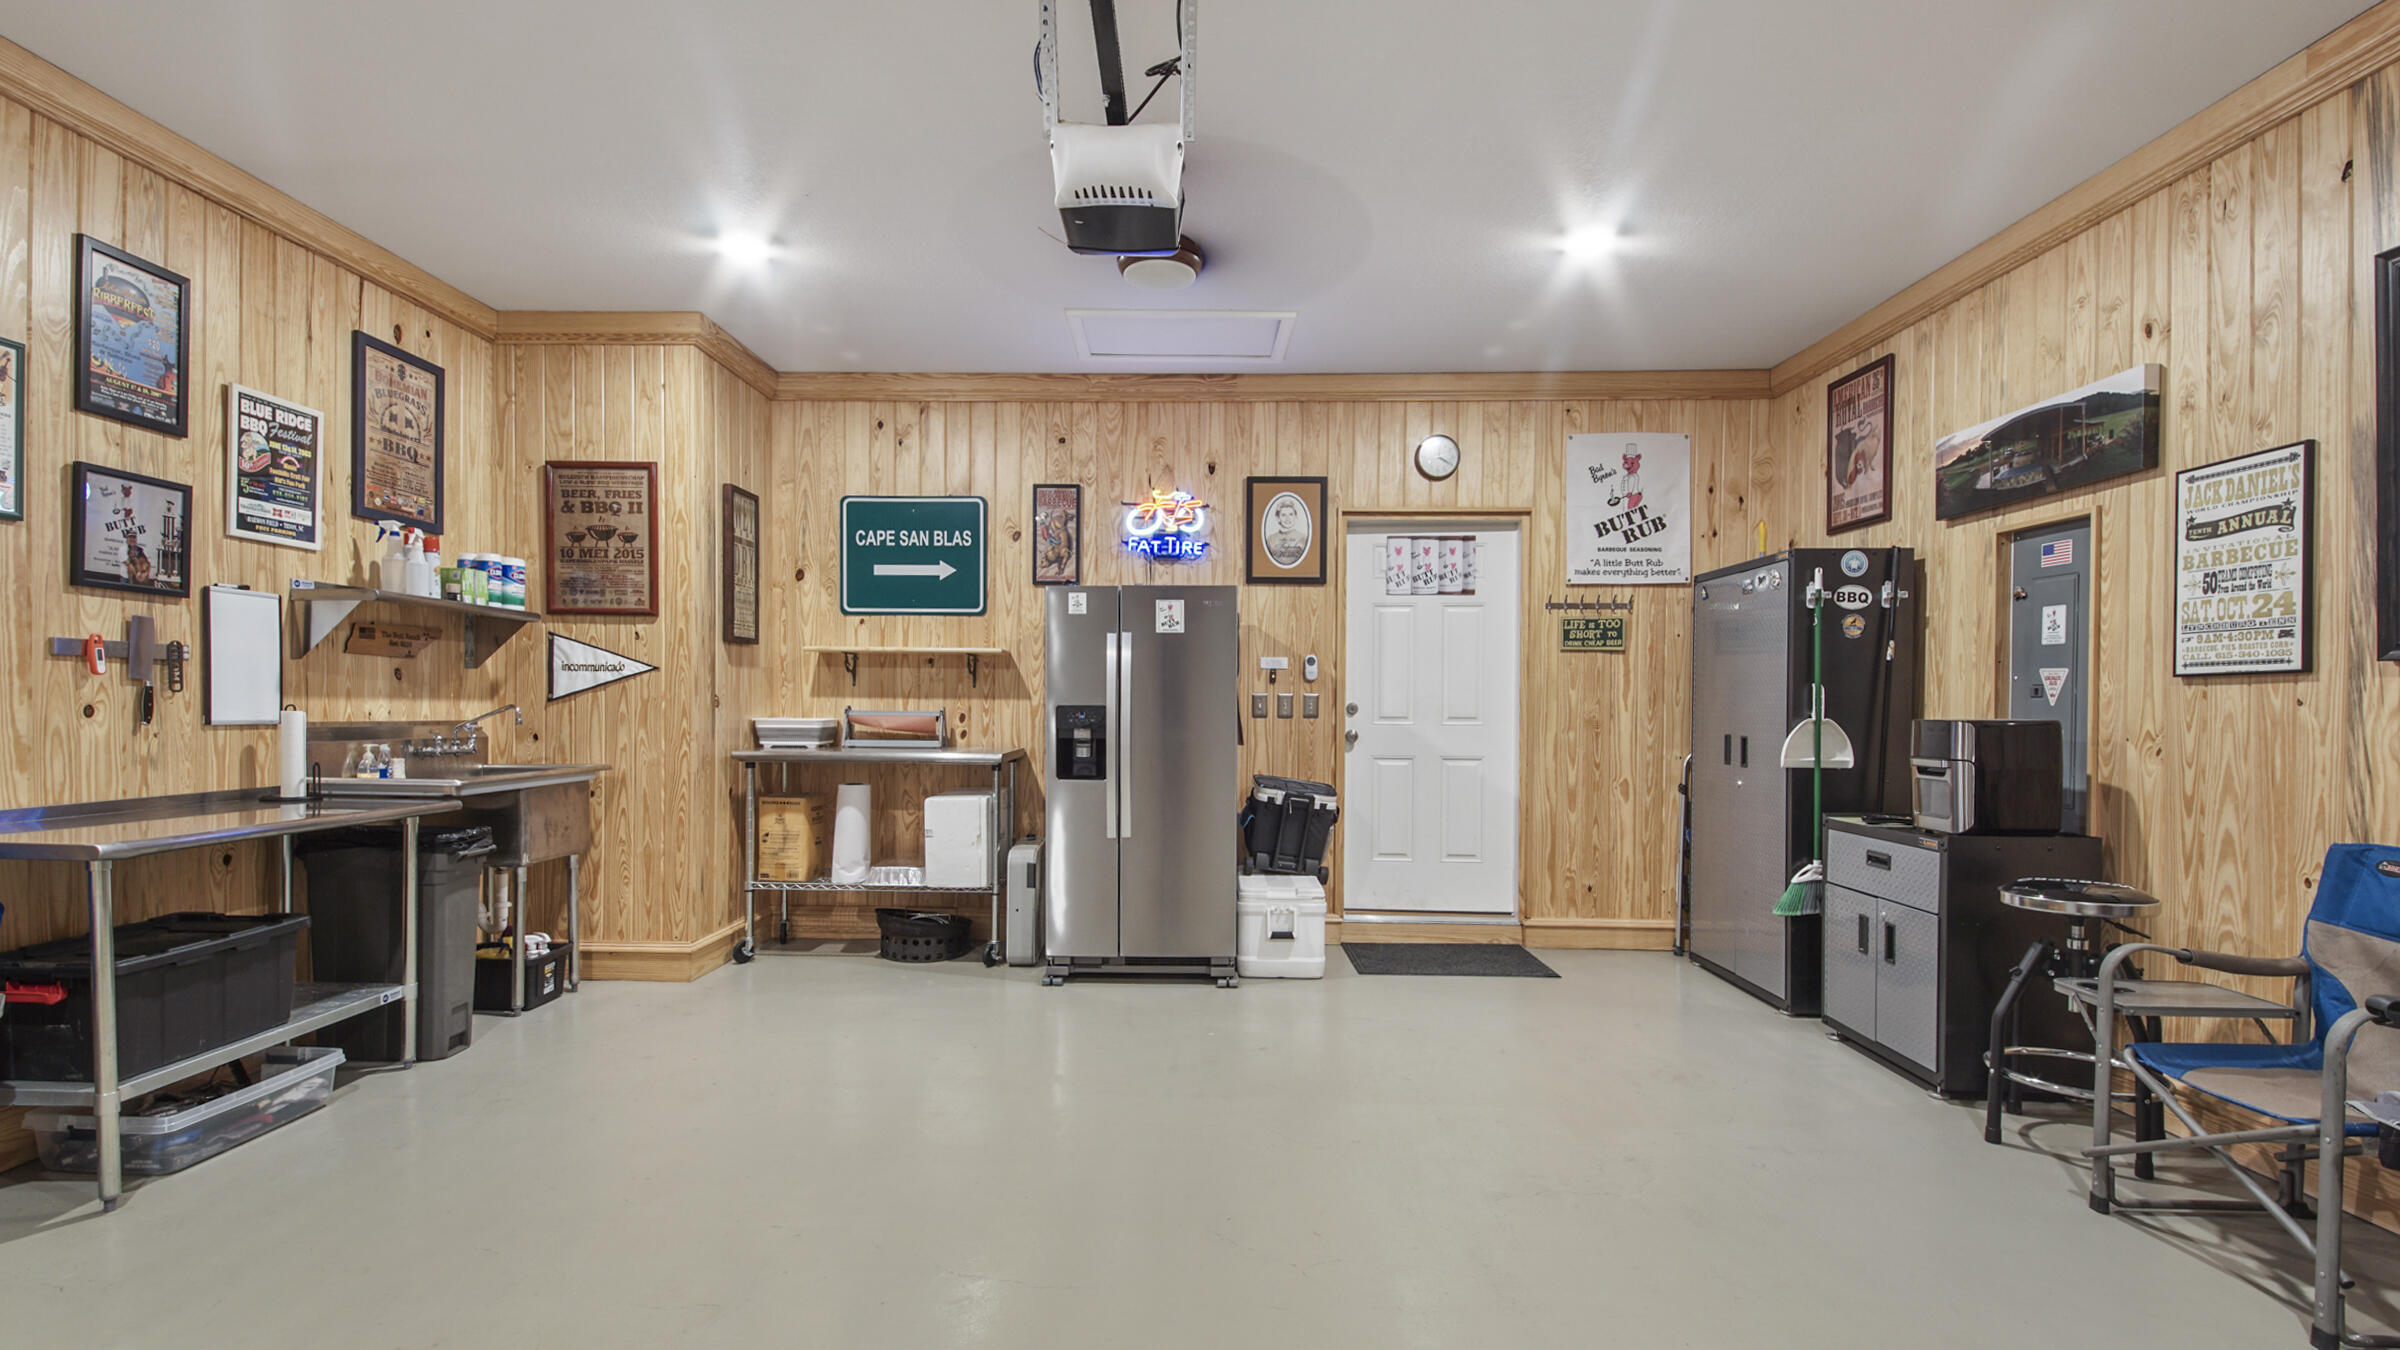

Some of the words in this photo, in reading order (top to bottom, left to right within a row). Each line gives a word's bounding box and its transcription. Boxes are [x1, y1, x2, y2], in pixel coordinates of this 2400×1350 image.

[93, 287, 155, 319] RIBBERFEST
[375, 368, 428, 400] BOHEMIAN
[374, 388, 427, 416] BLUEGRASS
[240, 398, 273, 421] BLUE
[275, 408, 313, 432] RIDGE
[240, 414, 269, 437] BBQ
[269, 421, 313, 446] Festival
[383, 437, 419, 464] BBQ
[1588, 463, 1604, 475] Bad
[1592, 468, 1617, 483] Byron's
[560, 489, 600, 500] BEER,
[604, 489, 642, 499] FRIES
[2184, 479, 2223, 509] JACK
[2225, 463, 2300, 502] DANIEL'S
[561, 500, 575, 514] &
[581, 501, 622, 517] BBQ
[627, 501, 643, 514] II
[2186, 505, 2219, 515] WORLD
[2221, 489, 2299, 508] CHAMPIONSHIP
[105, 516, 137, 532] BUTT
[1593, 504, 1649, 538] BUTT
[1621, 516, 1667, 544] RUB
[2217, 509, 2292, 535] ANNUAL
[856, 530, 895, 546] CAPE
[899, 530, 929, 546] SAN
[933, 530, 972, 546] BLAS
[1128, 536, 1162, 554] FAT
[1164, 536, 1204, 555] TIRE
[2186, 533, 2295, 554] INVITATIONAL
[560, 548, 574, 559] 10
[580, 548, 609, 559] MEI
[614, 548, 644, 559] 2015
[1603, 558, 1622, 567] little
[1624, 559, 1644, 567] Butt
[1646, 558, 1664, 567] Rub
[2182, 539, 2298, 571] BARBECUE
[1574, 568, 1601, 576] makes
[1602, 568, 1649, 577] everything
[2202, 571, 2218, 595] 50
[1836, 591, 1869, 604] BBQ
[2181, 598, 2214, 625] SAT.
[2217, 595, 2250, 621] OCT.
[2251, 590, 2297, 619] 24
[1563, 620, 1586, 629] LIFE
[1597, 619, 1621, 629] TOO
[1569, 629, 1603, 639] SHORT
[561, 660, 625, 672] incommunicado
[2182, 653, 2212, 661] CALL
